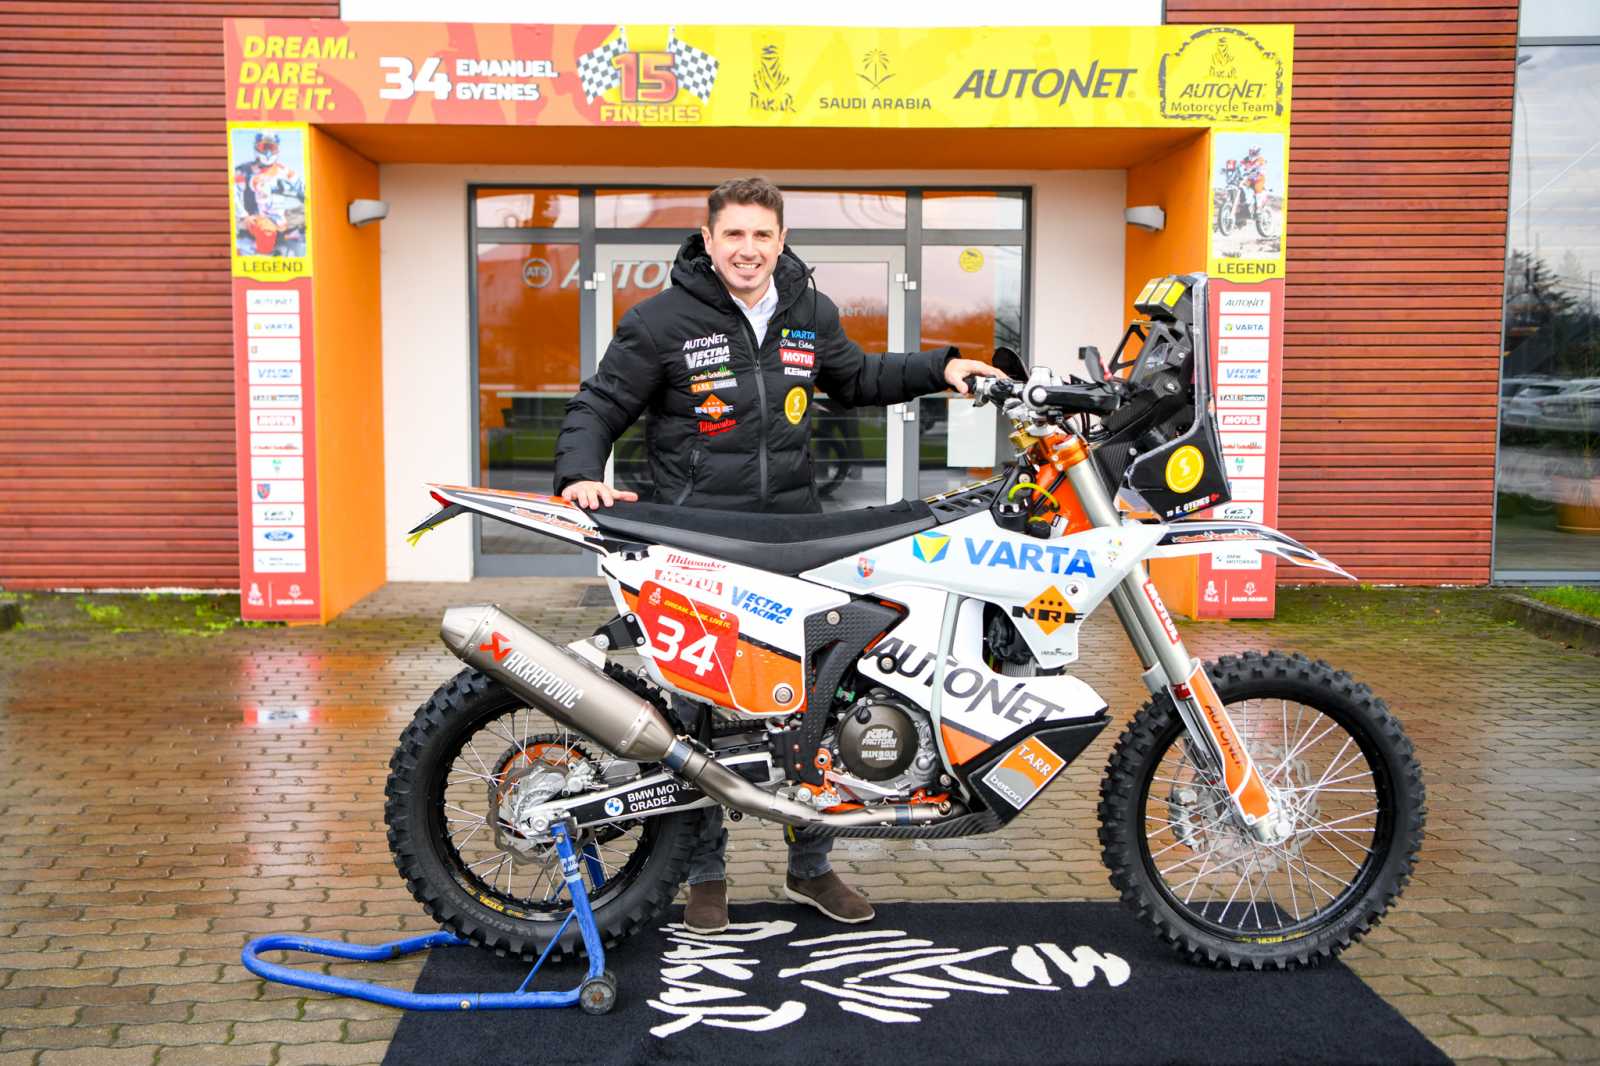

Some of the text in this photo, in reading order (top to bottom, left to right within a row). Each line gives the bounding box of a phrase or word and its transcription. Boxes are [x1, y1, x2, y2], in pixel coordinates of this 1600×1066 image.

[243, 35, 357, 60] DREAM.
[239, 61, 325, 85] DARE.
[379, 56, 453, 100] 34
[455, 59, 560, 78] EMANUEL
[612, 51, 680, 104] 15
[235, 87, 336, 111] LIVE IT.
[455, 82, 540, 101] GYENES
[600, 105, 702, 123] FINISHES
[819, 97, 932, 110] SAUDI ARABIA
[1170, 102, 1274, 114] Motorcycle Team
[242, 261, 303, 273] LEGEND
[1217, 263, 1277, 275] LEGEND
[790, 330, 816, 341] VARTA
[1235, 323, 1264, 331] VARTA
[685, 345, 730, 369] VECTRA
[783, 351, 814, 365] MOTUL
[964, 537, 1097, 579] VARTA
[731, 585, 794, 618] VECTRA
[741, 602, 788, 625] RACING
[651, 615, 719, 677] 34
[863, 636, 1065, 725] AUTONET
[1018, 744, 1052, 777] TARR
[627, 783, 680, 803] BMW MOT
[629, 794, 677, 812] ORADEA
[646, 919, 807, 1038] DAKAR
